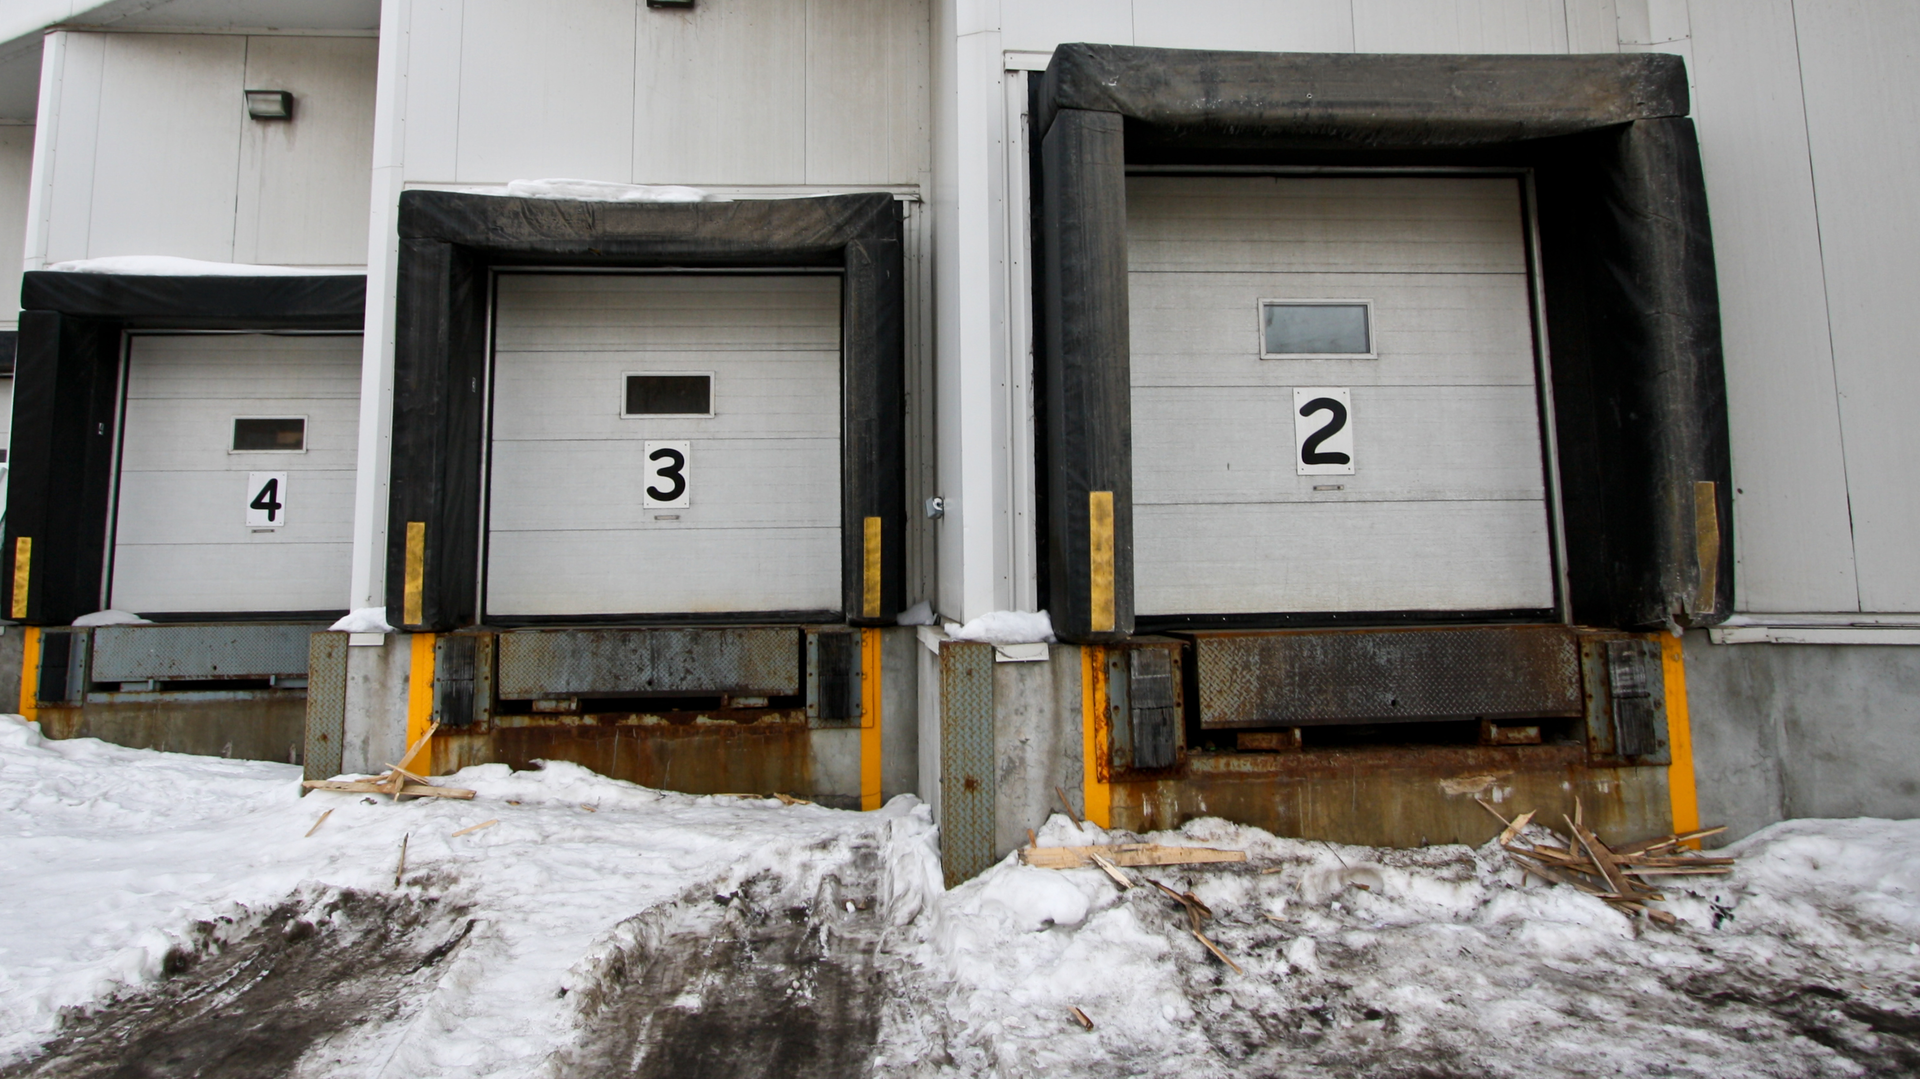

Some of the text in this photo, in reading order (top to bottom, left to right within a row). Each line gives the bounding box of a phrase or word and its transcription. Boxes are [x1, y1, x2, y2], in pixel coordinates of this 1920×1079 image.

[1299, 397, 1351, 465] 2
[249, 478, 282, 522] 4
[646, 448, 686, 502] 3
